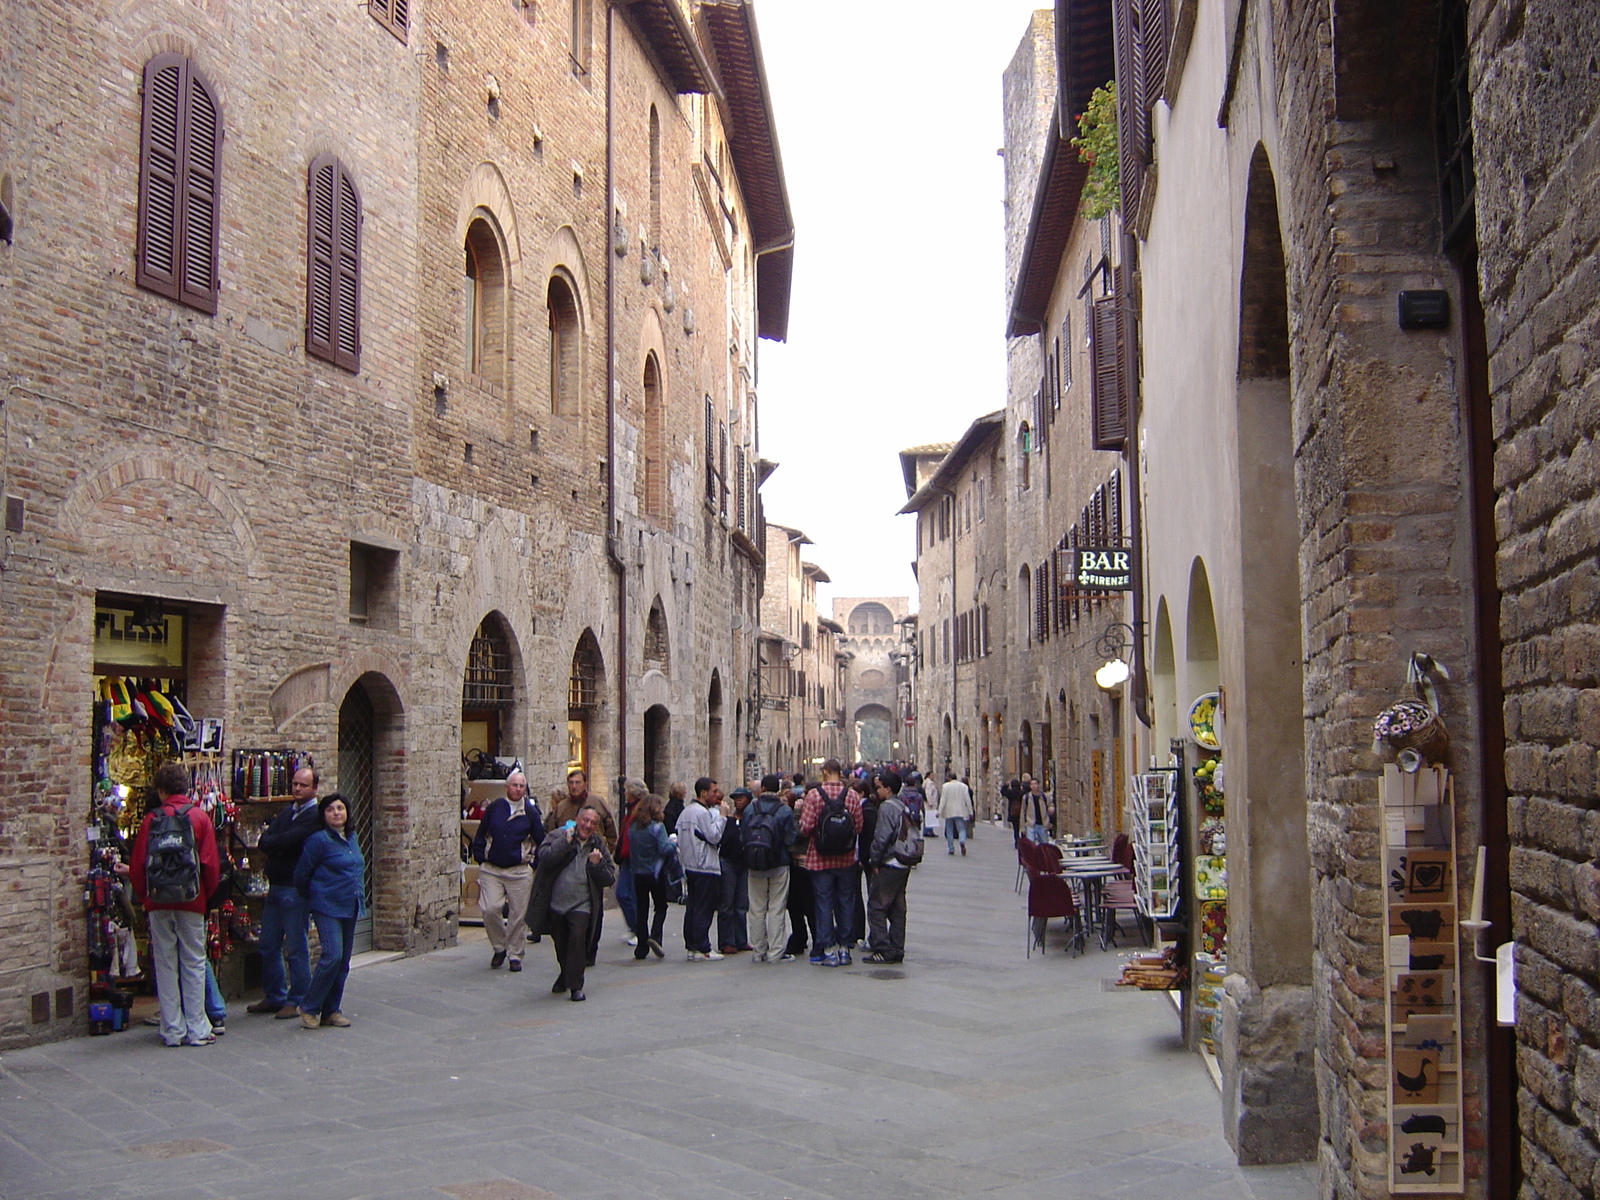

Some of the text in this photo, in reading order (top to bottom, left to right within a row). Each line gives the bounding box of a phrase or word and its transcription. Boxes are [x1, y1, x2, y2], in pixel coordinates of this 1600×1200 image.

[1080, 551, 1130, 570] BAR
[1090, 574, 1130, 586] FIRENZE
[1093, 760, 1101, 828] ENOTECA
